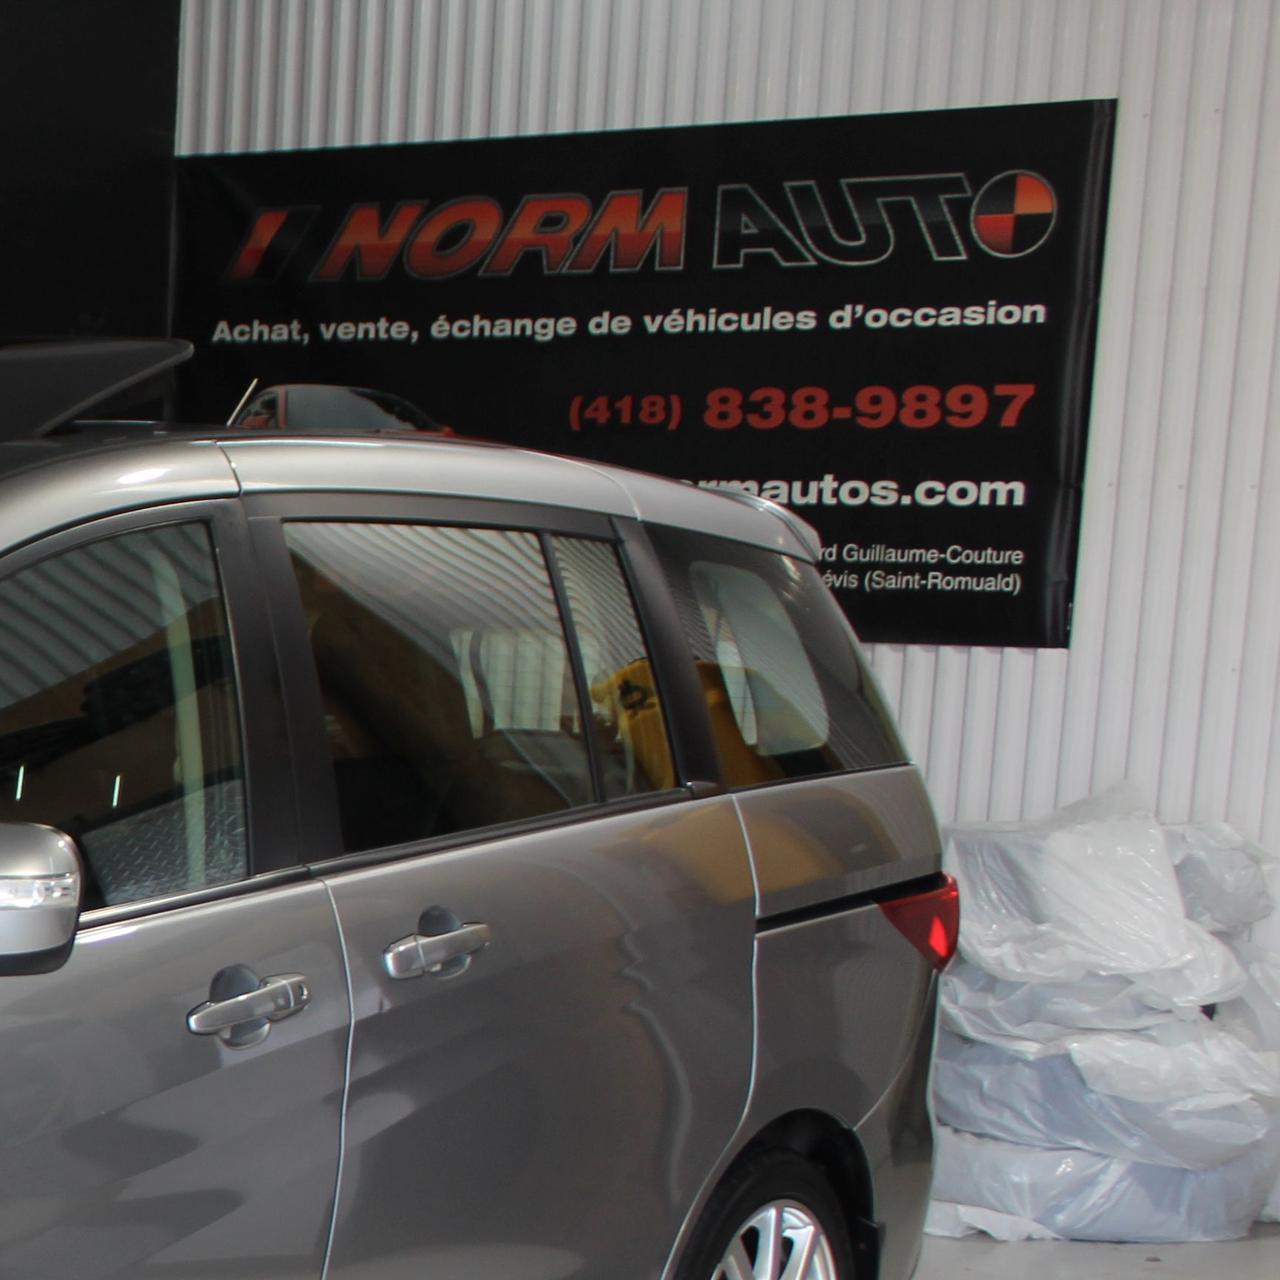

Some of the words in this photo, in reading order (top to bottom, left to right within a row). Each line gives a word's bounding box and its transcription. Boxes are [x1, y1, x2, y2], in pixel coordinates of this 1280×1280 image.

[309, 188, 689, 282] NORM
[711, 169, 1058, 269] AUTO
[211, 319, 310, 346] Achat,
[319, 316, 419, 345] vente,
[430, 313, 577, 342] échange
[587, 310, 632, 336] de
[643, 306, 817, 335] véhicules
[568, 394, 681, 431] (418)
[702, 383, 1036, 430] 838-9897
[842, 543, 1024, 564] Guillaume-Couture
[864, 570, 1022, 594] (Saint-Romuald)
